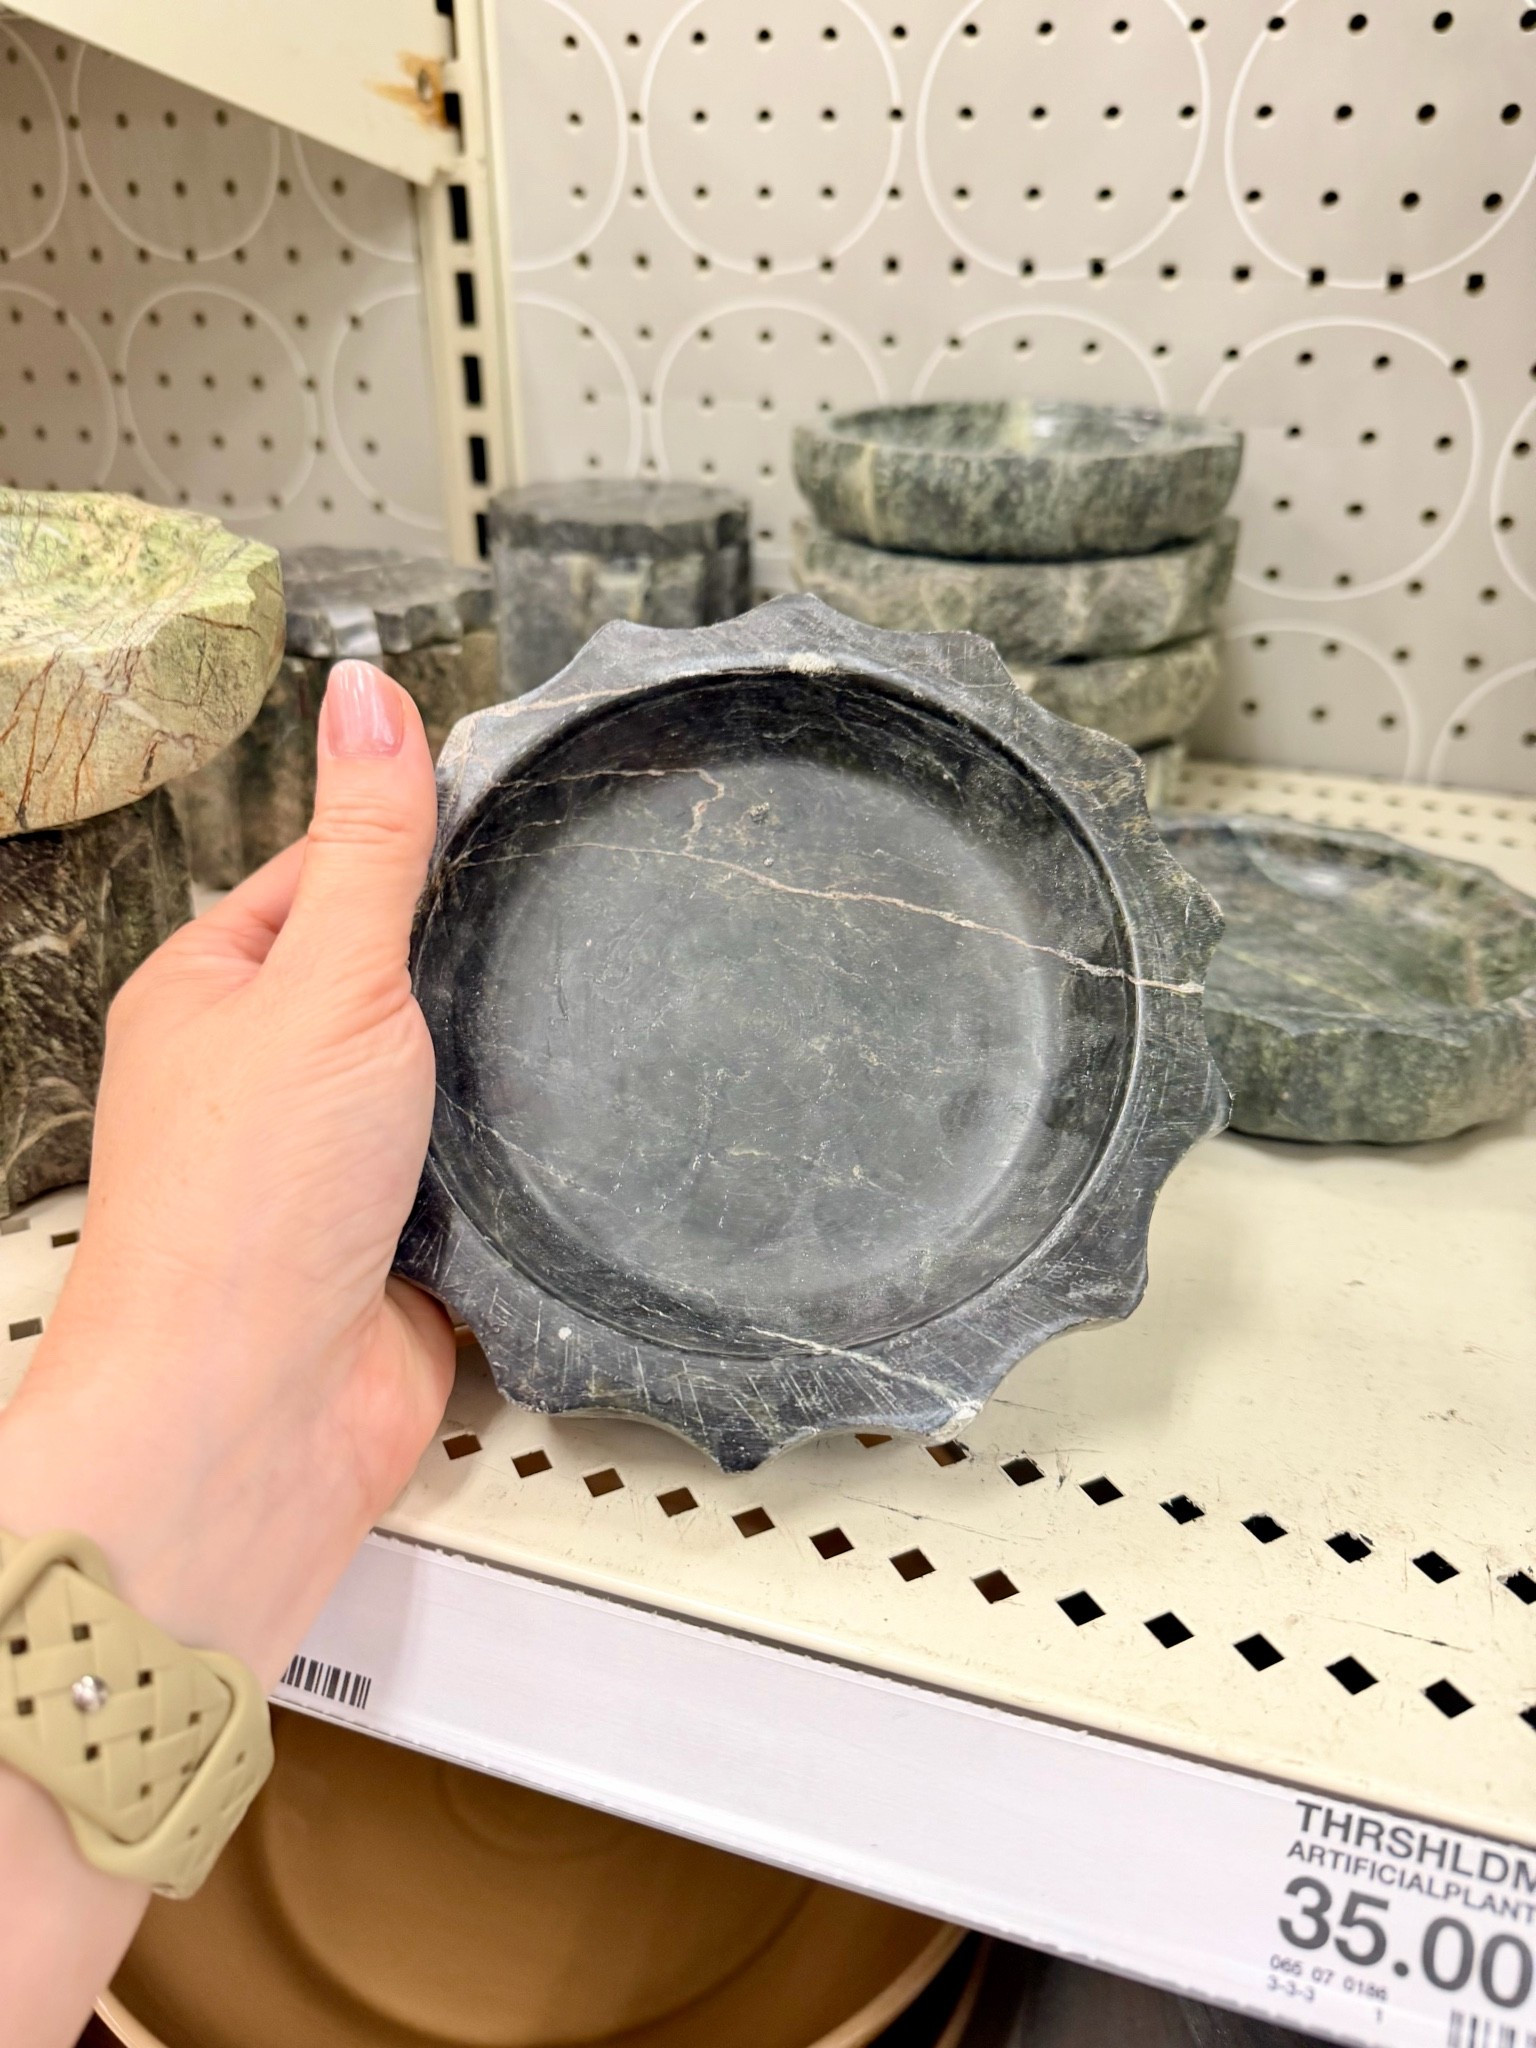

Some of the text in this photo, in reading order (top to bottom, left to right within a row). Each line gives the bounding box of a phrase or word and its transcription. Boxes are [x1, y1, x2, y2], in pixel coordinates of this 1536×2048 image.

[1278, 1875, 1533, 2009] 35.00
[1267, 1974, 1315, 2002] 3-3-3
[1311, 1967, 1334, 1984] 07
